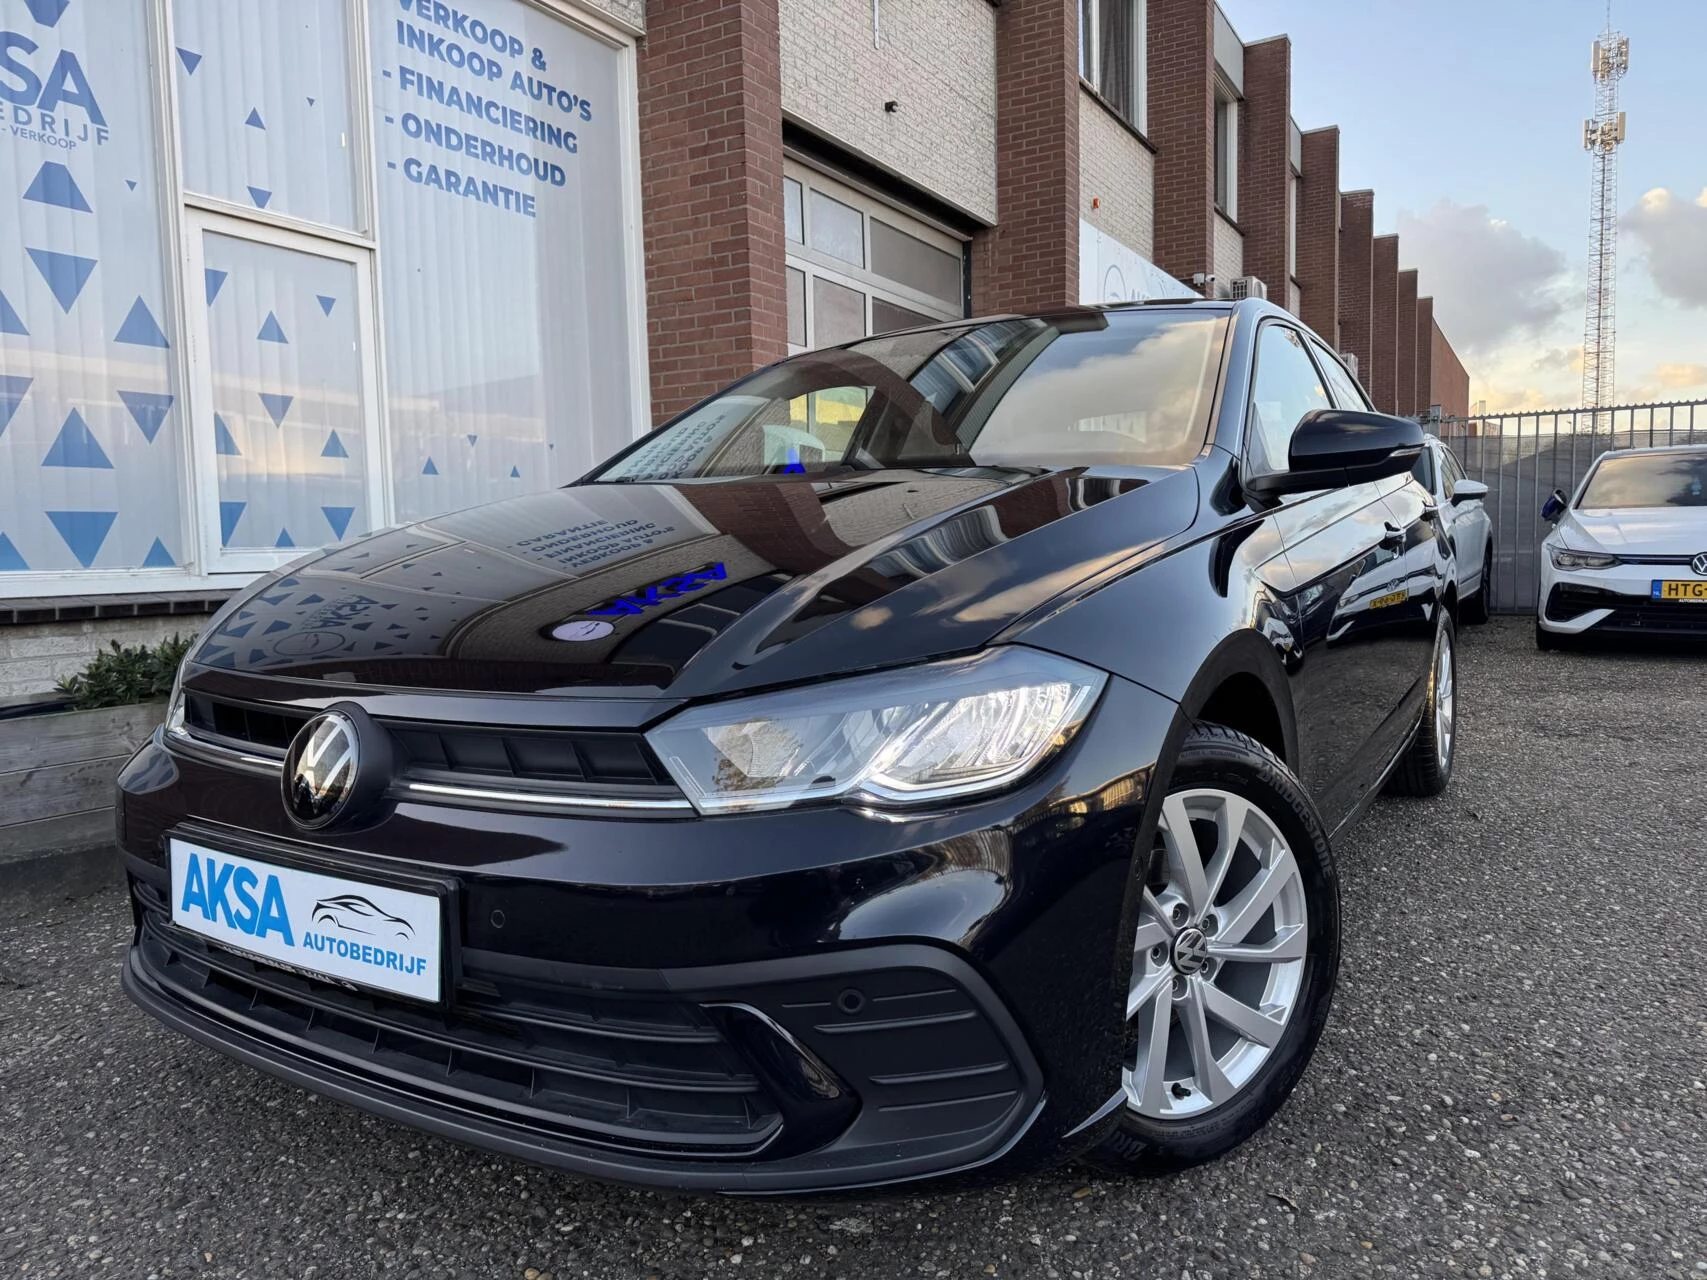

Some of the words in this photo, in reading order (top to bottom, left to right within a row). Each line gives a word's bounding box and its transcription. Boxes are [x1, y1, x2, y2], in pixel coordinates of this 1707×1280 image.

[397, 19, 503, 82] INKOOP
[510, 70, 592, 121] AUTO'S
[531, 47, 547, 72] &
[10, 125, 77, 150] VERKOOP
[399, 65, 578, 154] FINANCIERING
[401, 112, 566, 187] ONDERHOUD
[403, 157, 537, 218] GARANTIE
[181, 852, 295, 947] AKSA
[302, 931, 427, 976] AUTOBEDRIJF
